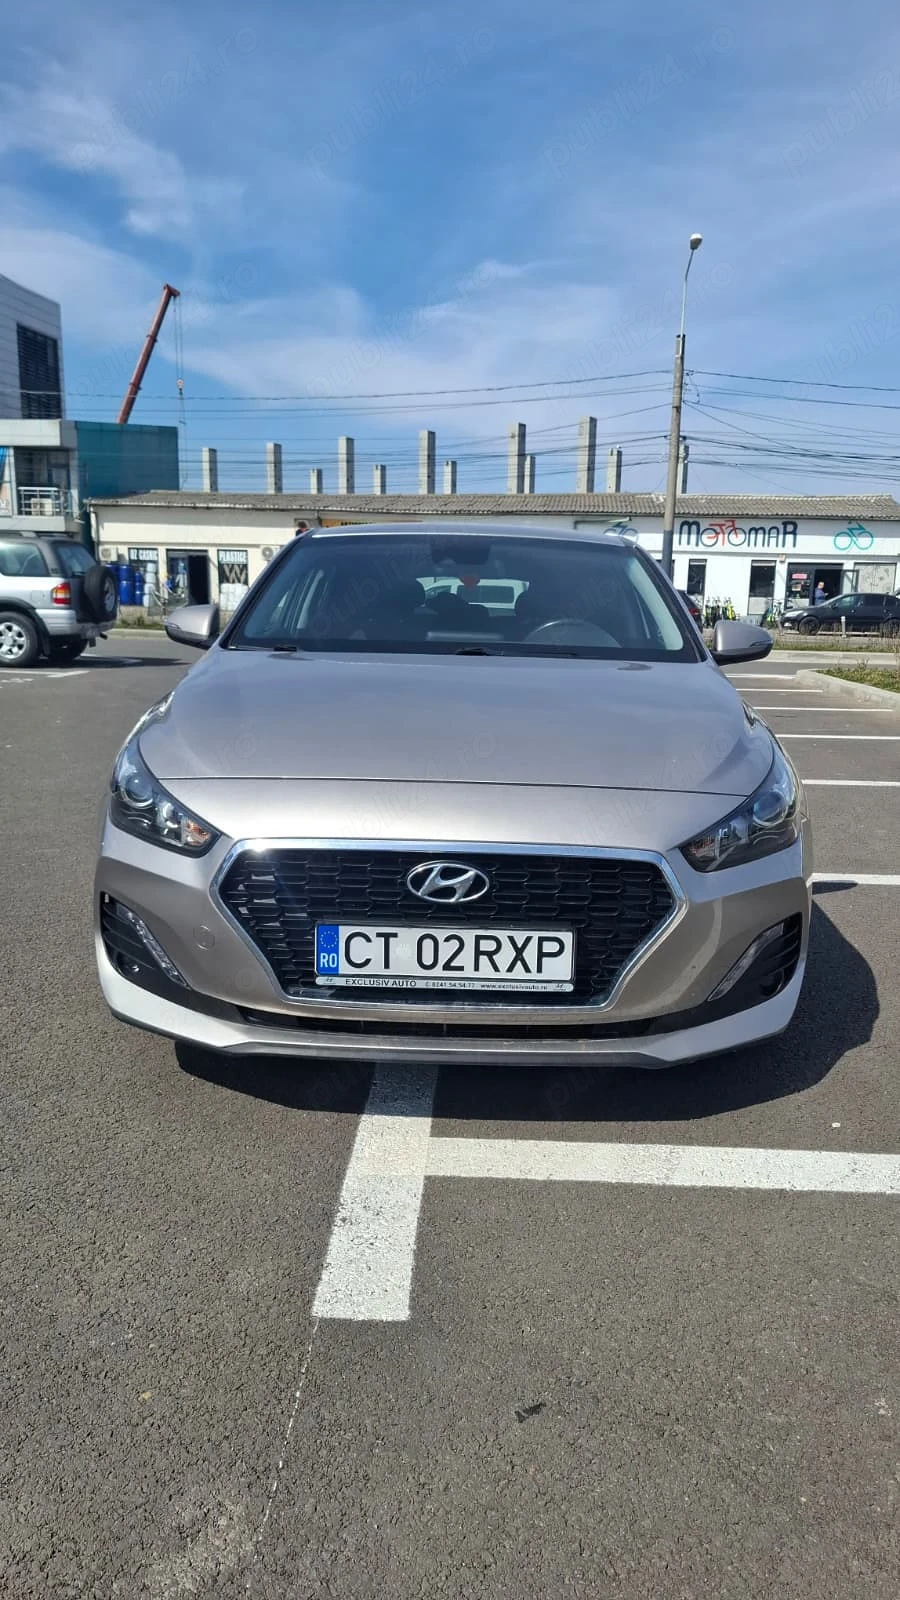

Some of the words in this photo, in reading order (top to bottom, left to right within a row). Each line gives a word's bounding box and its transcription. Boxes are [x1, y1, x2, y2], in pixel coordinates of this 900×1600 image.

[344, 931, 398, 970] CT
[320, 953, 337, 968] RO
[345, 978, 390, 986] EXCLUSIV
[391, 979, 417, 987] AUTO
